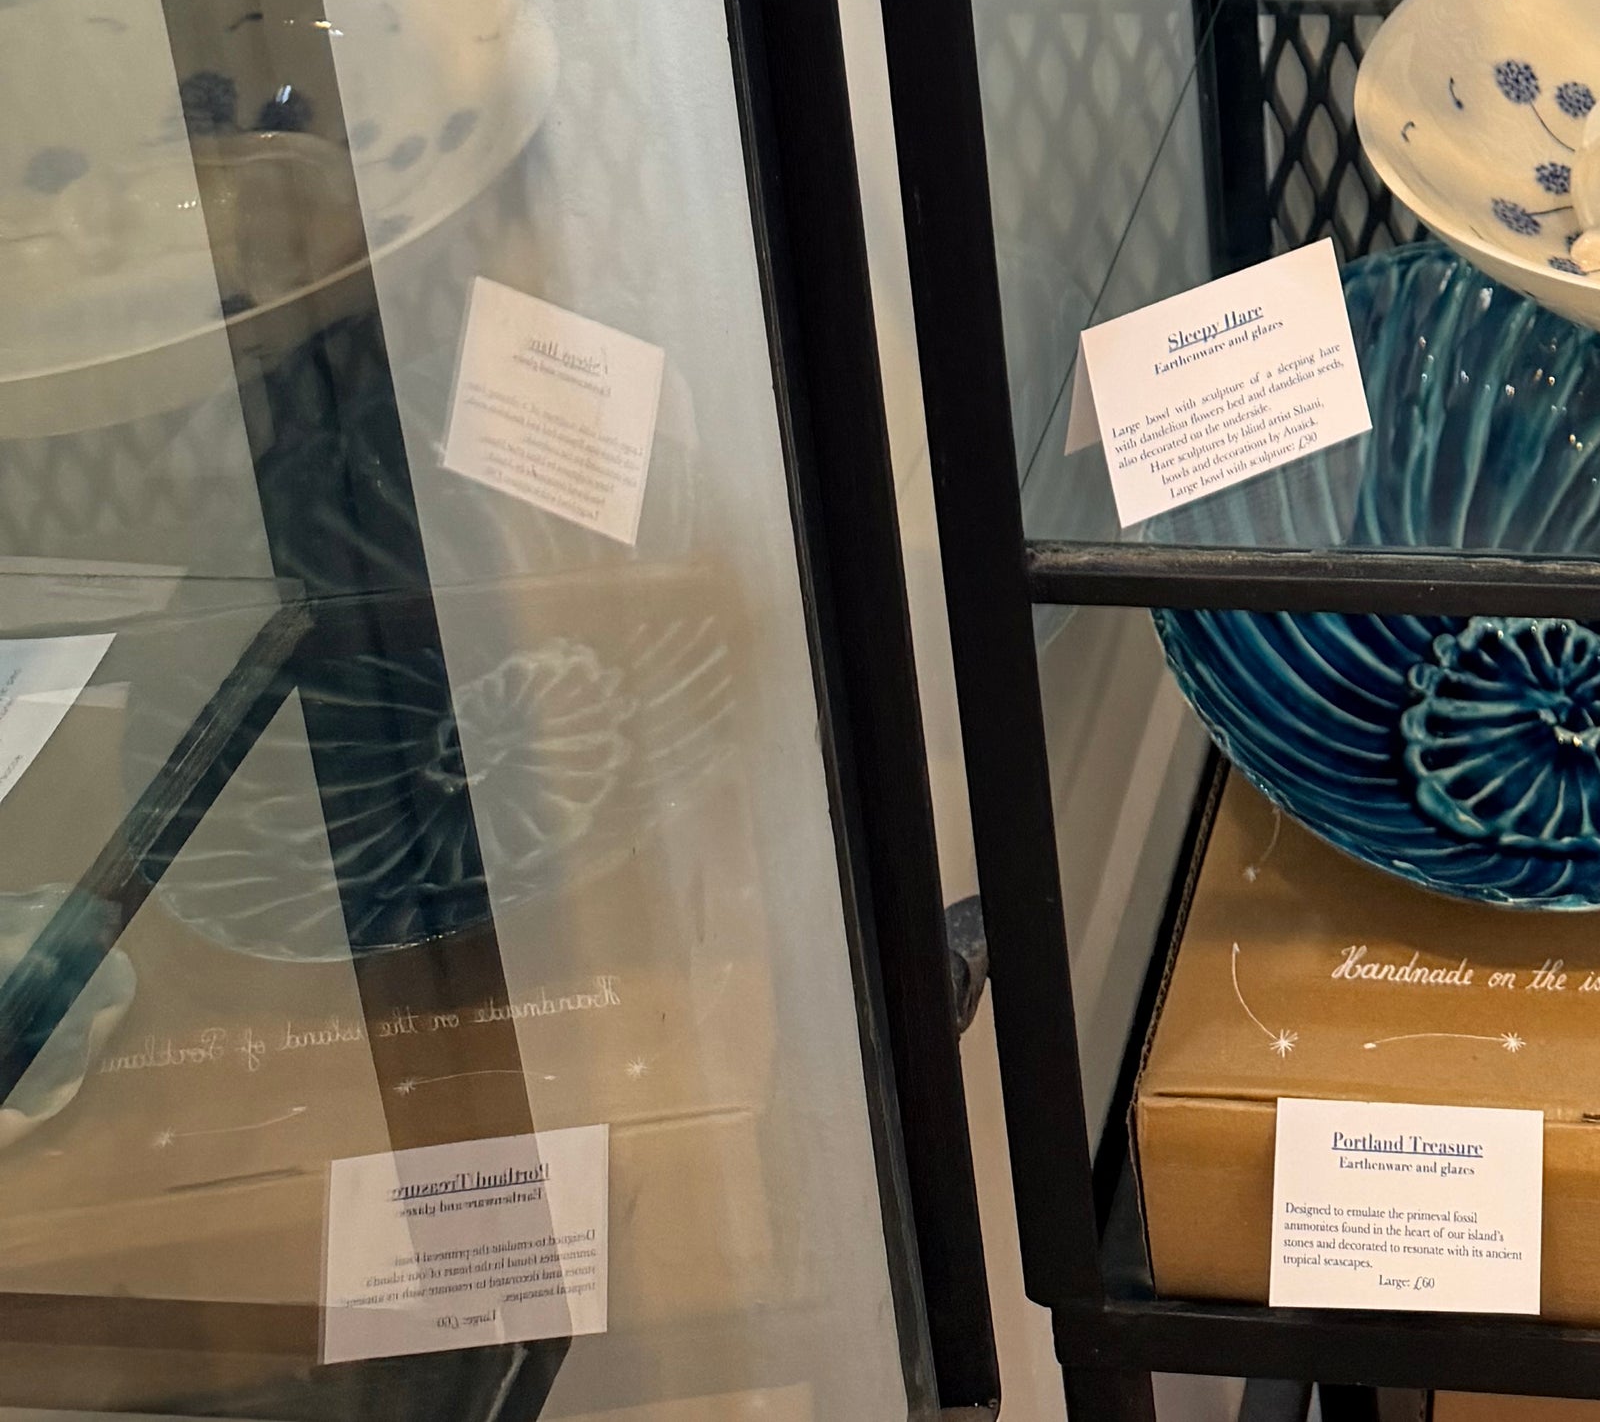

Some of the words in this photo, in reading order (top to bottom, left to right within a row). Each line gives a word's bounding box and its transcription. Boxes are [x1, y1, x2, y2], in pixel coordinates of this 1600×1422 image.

[1154, 342, 1225, 375] Earthenware
[1228, 330, 1248, 347] and
[1251, 321, 1283, 341] glazes
[1167, 322, 1219, 348] Sleepy
[1224, 306, 1263, 328] Hare
[1111, 421, 1140, 439] Large
[1145, 406, 1170, 426] bowl
[1174, 397, 1196, 414] with
[1201, 381, 1244, 404] sculpture
[1249, 371, 1259, 385] of
[1266, 370, 1272, 379] a
[1277, 353, 1315, 375] sleeping
[1319, 344, 1340, 358] hare
[1169, 481, 1198, 499] Large
[1199, 467, 1224, 486] bowl
[1225, 460, 1247, 475] with
[1249, 442, 1295, 467] sculpture:
[1331, 944, 1474, 985] Handmade
[1488, 971, 1517, 990] on
[1525, 958, 1568, 991] the
[1331, 1132, 1404, 1152] Portland
[1408, 1135, 1483, 1155] Treasure
[1339, 1156, 1413, 1172] Earthenware
[1415, 1161, 1437, 1173] and
[1440, 1161, 1475, 1177] glazes
[1285, 1202, 1331, 1218] Designed
[1333, 1207, 1344, 1216] to
[1346, 1205, 1385, 1218] emulate
[1388, 1207, 1404, 1220] the
[1406, 1210, 1450, 1223] primeval
[1453, 1210, 1477, 1224] fossil
[1378, 1273, 1410, 1290] Large:
